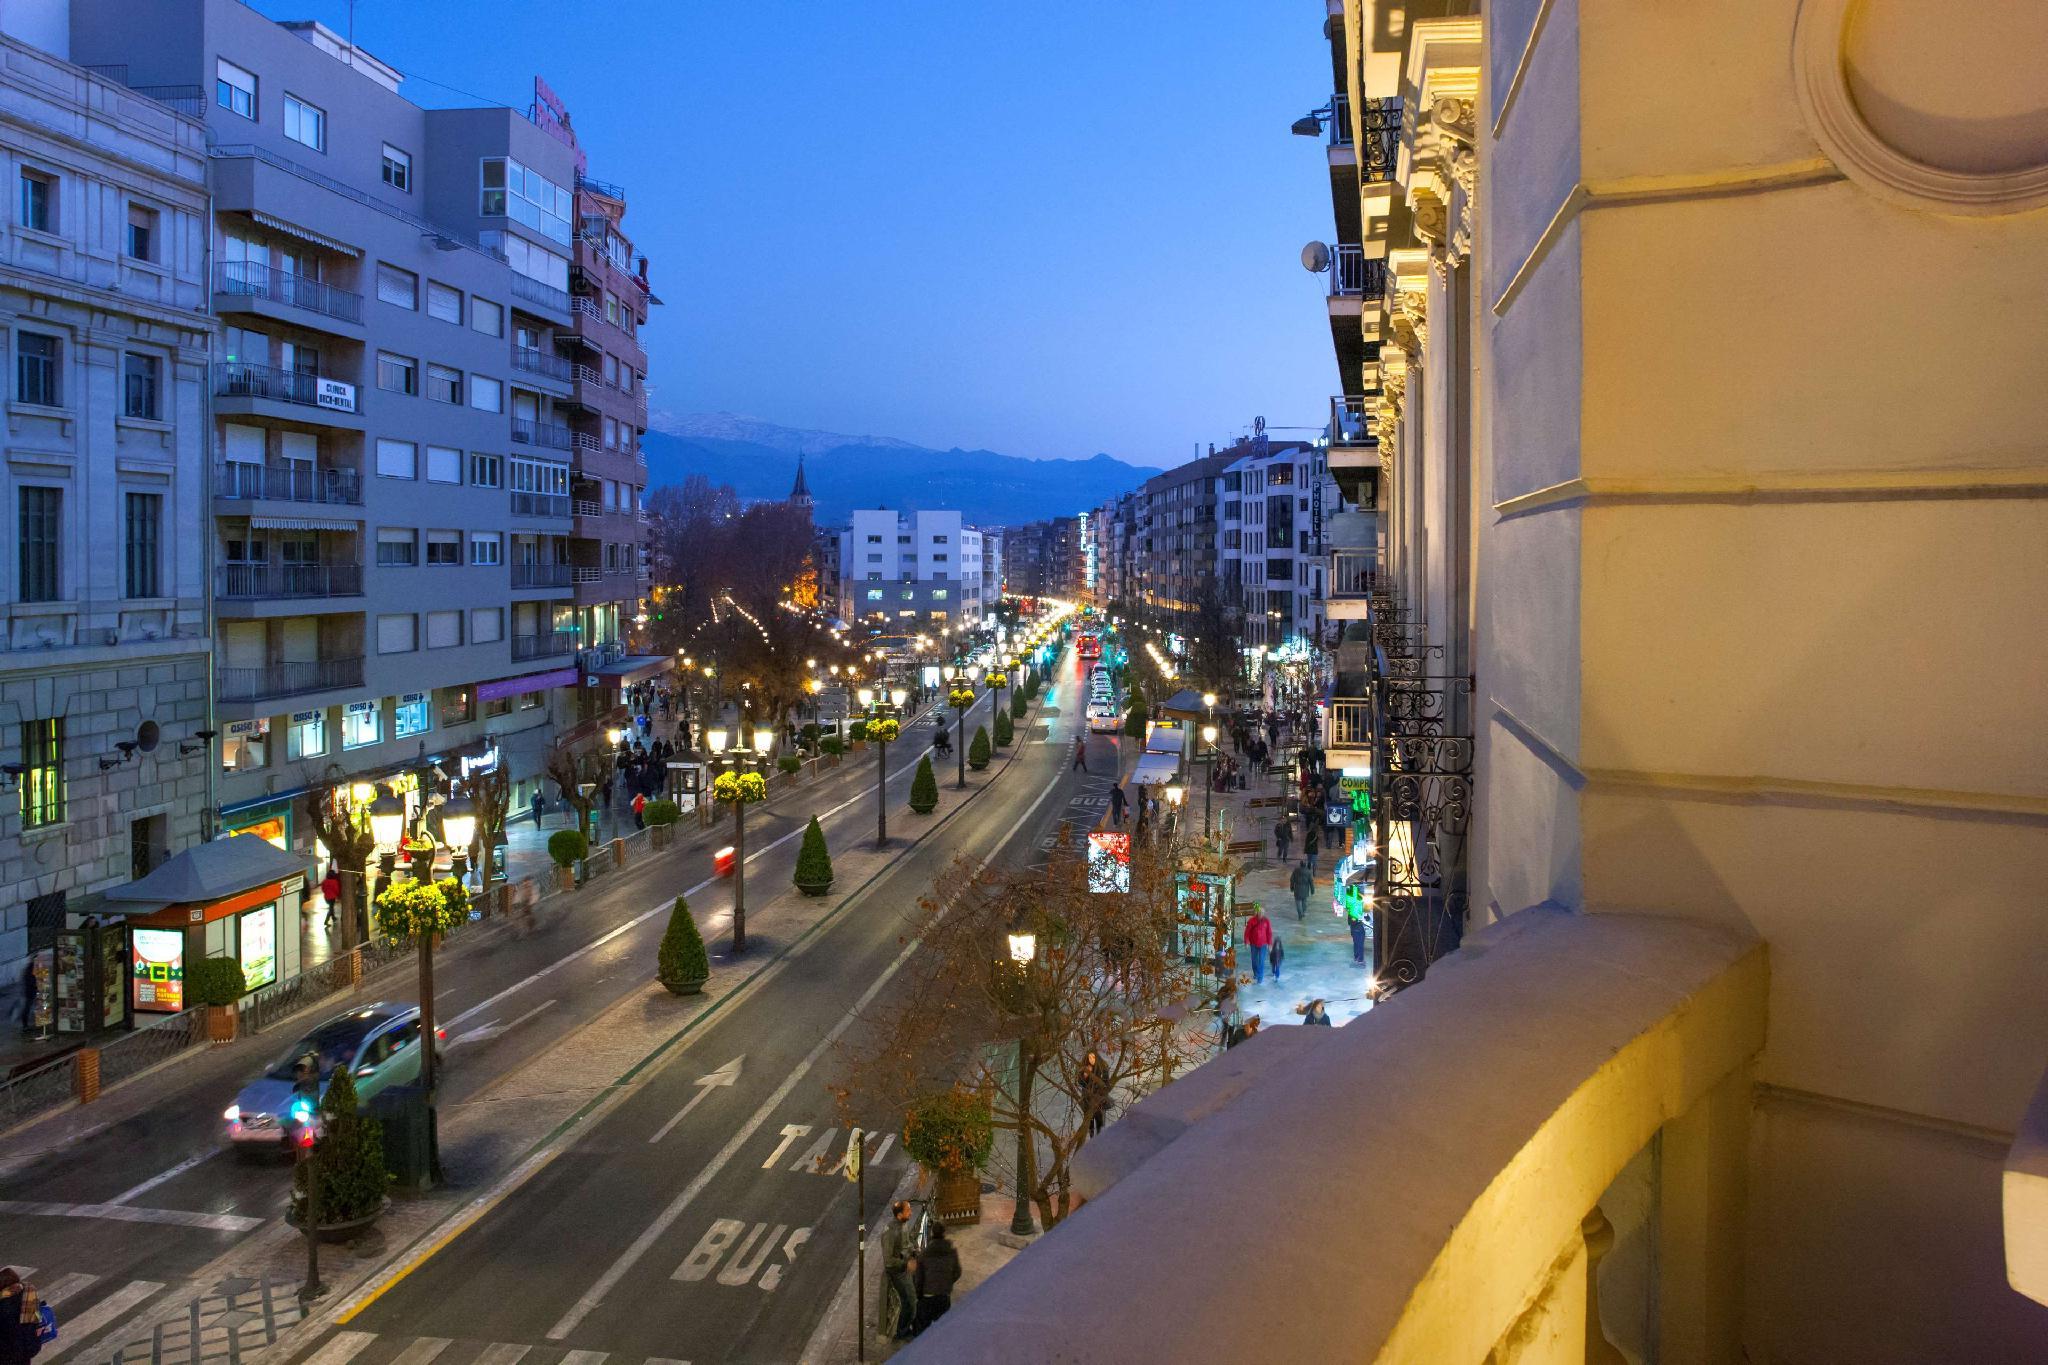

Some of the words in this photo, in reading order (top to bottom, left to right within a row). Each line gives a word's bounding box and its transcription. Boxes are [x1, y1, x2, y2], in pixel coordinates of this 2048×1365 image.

[402, 693, 418, 703] asisa
[349, 702, 367, 713] asisa
[293, 711, 313, 723] asisa
[230, 720, 253, 734] asisa
[1069, 797, 1109, 806] BUS
[1041, 838, 1086, 848] BS
[761, 1124, 897, 1177] TAXI
[669, 1218, 814, 1291] BUS
